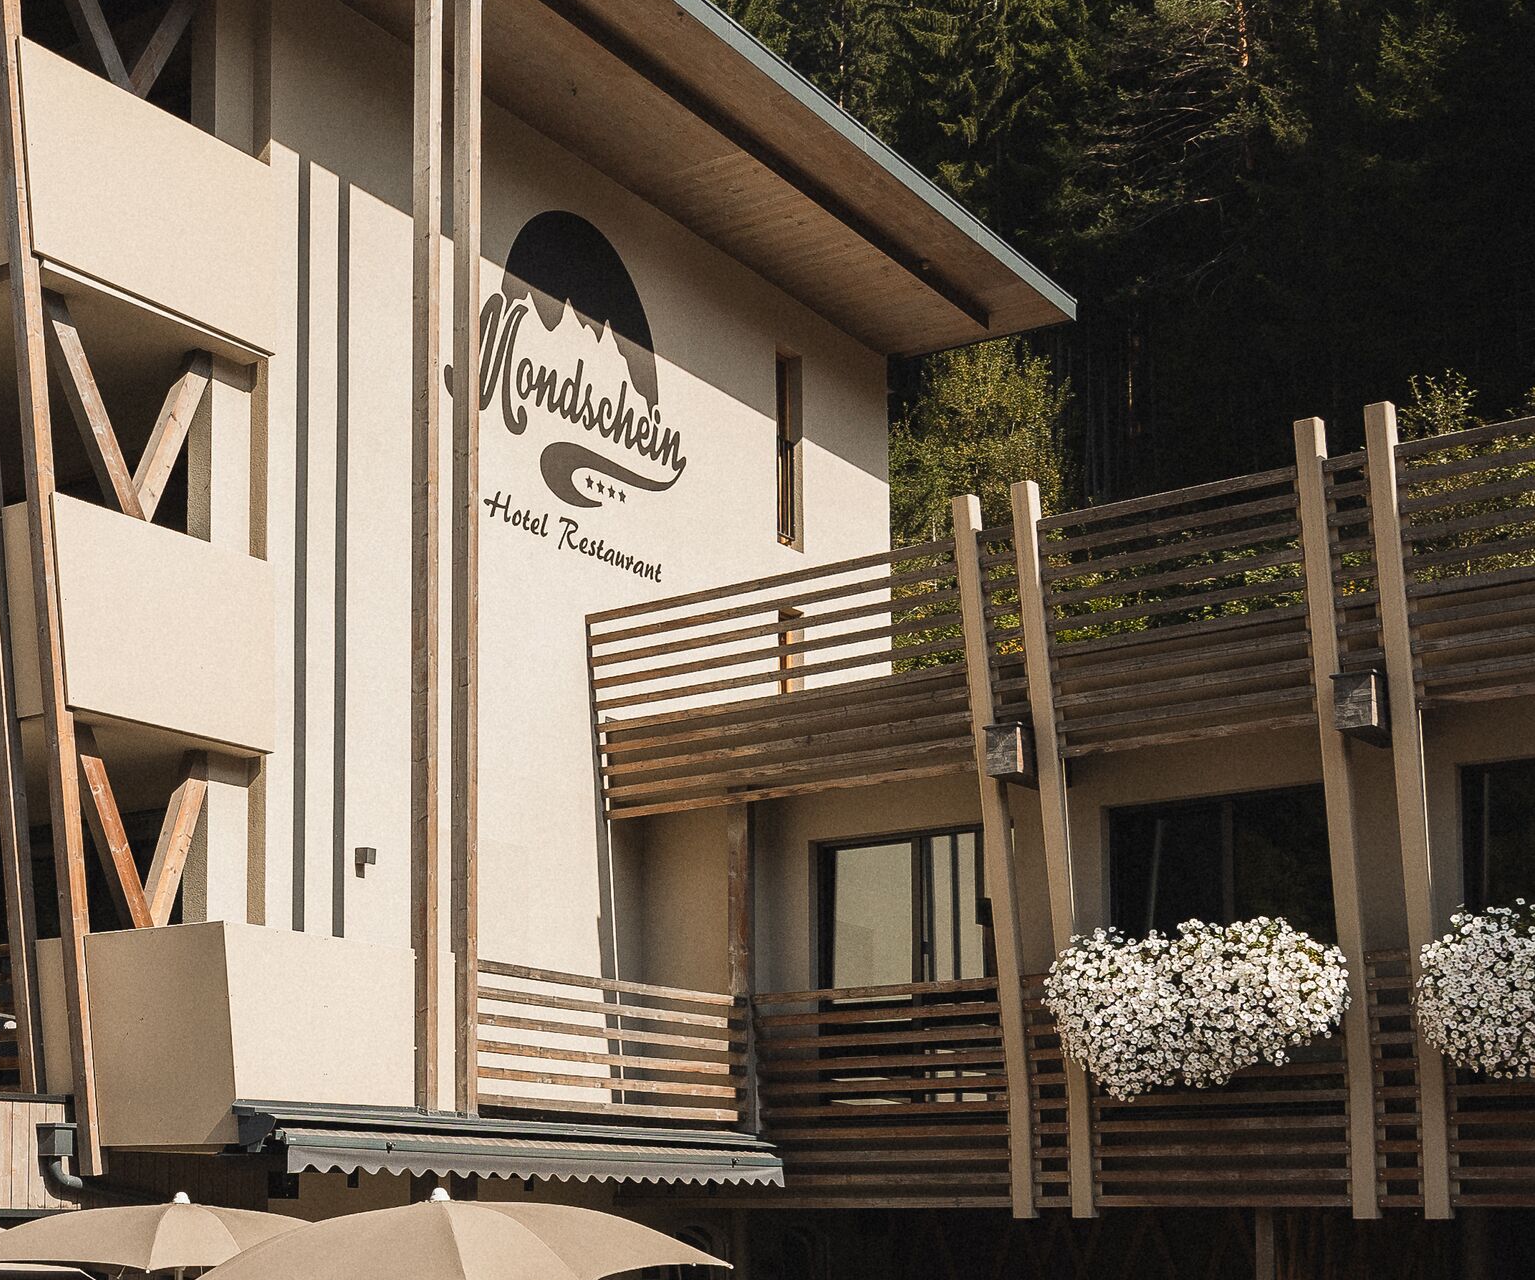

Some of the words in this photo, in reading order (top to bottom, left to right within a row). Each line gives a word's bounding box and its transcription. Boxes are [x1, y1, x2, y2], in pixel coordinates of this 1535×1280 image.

[444, 293, 686, 472] Mondschein
[483, 490, 549, 538] Hotel
[557, 516, 662, 583] Restaurant
